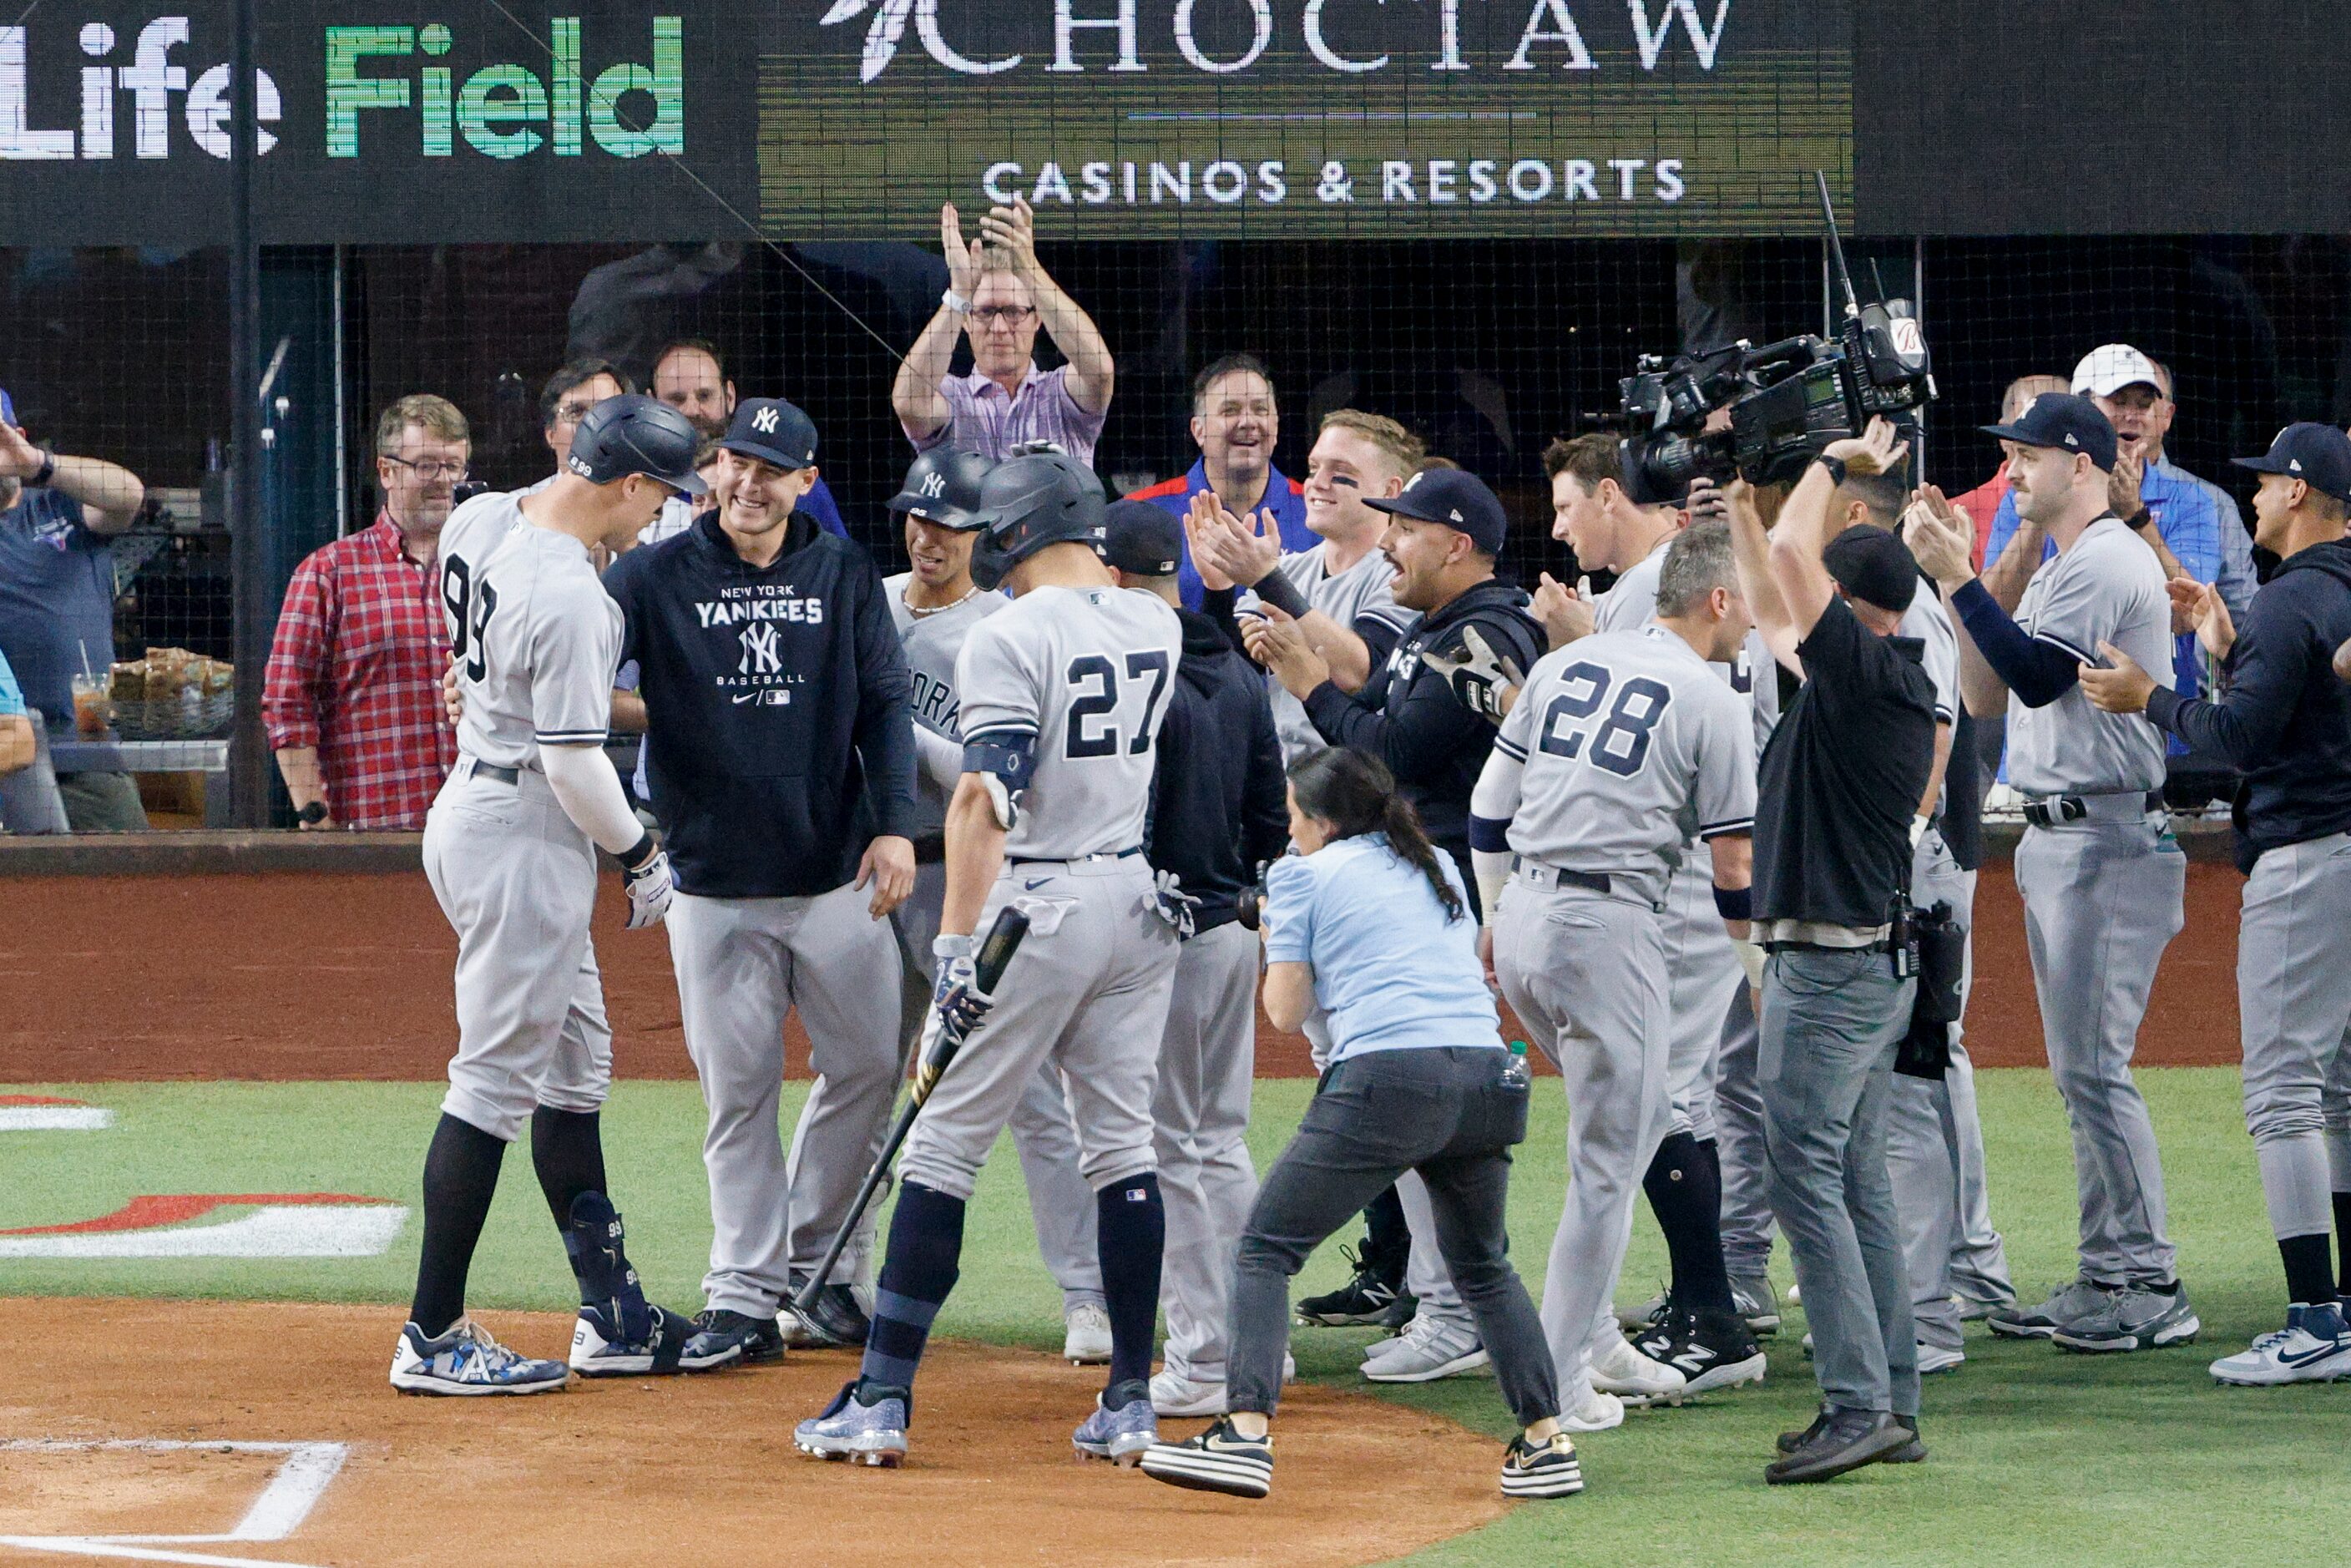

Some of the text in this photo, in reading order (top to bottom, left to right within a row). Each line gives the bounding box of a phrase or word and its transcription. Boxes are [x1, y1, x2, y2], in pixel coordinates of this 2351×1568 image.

[915, 0, 1729, 73] CHOCTAW
[0, 17, 683, 159] Life Field
[982, 159, 1686, 205] CASINOS & RESORTS
[578, 461, 592, 476] 99
[694, 598, 823, 629] YANKEES
[721, 584, 795, 599] NEW YORK
[716, 674, 806, 685] BASEBALL
[908, 667, 961, 736] ORK
[1064, 649, 1170, 760] 27
[1539, 660, 1672, 779] 28
[608, 1220, 623, 1238] 99
